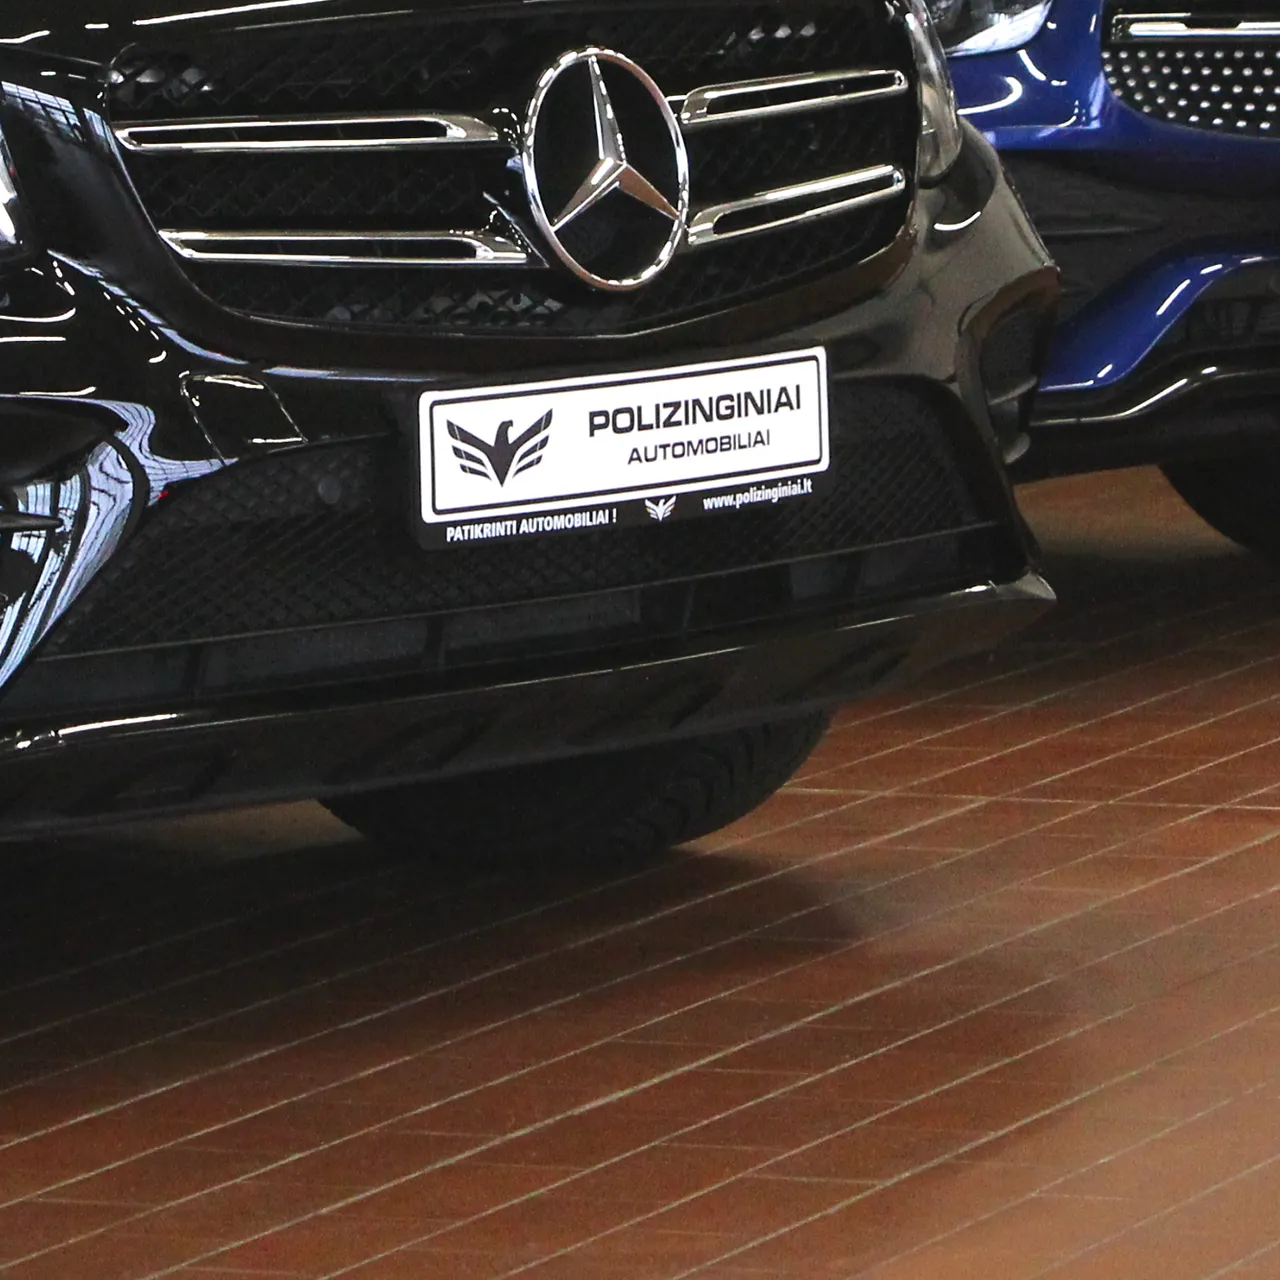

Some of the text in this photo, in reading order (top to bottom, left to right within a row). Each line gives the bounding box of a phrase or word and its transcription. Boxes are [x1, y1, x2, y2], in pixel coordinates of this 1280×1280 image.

[588, 384, 801, 438] POLIZINGINIAI
[627, 429, 771, 465] AUTOMOBILIAI
[703, 478, 813, 512] www.polizinginiai.lt
[446, 520, 517, 543] PATIKRINTI
[519, 510, 610, 535] AUTOMOBILIAI
